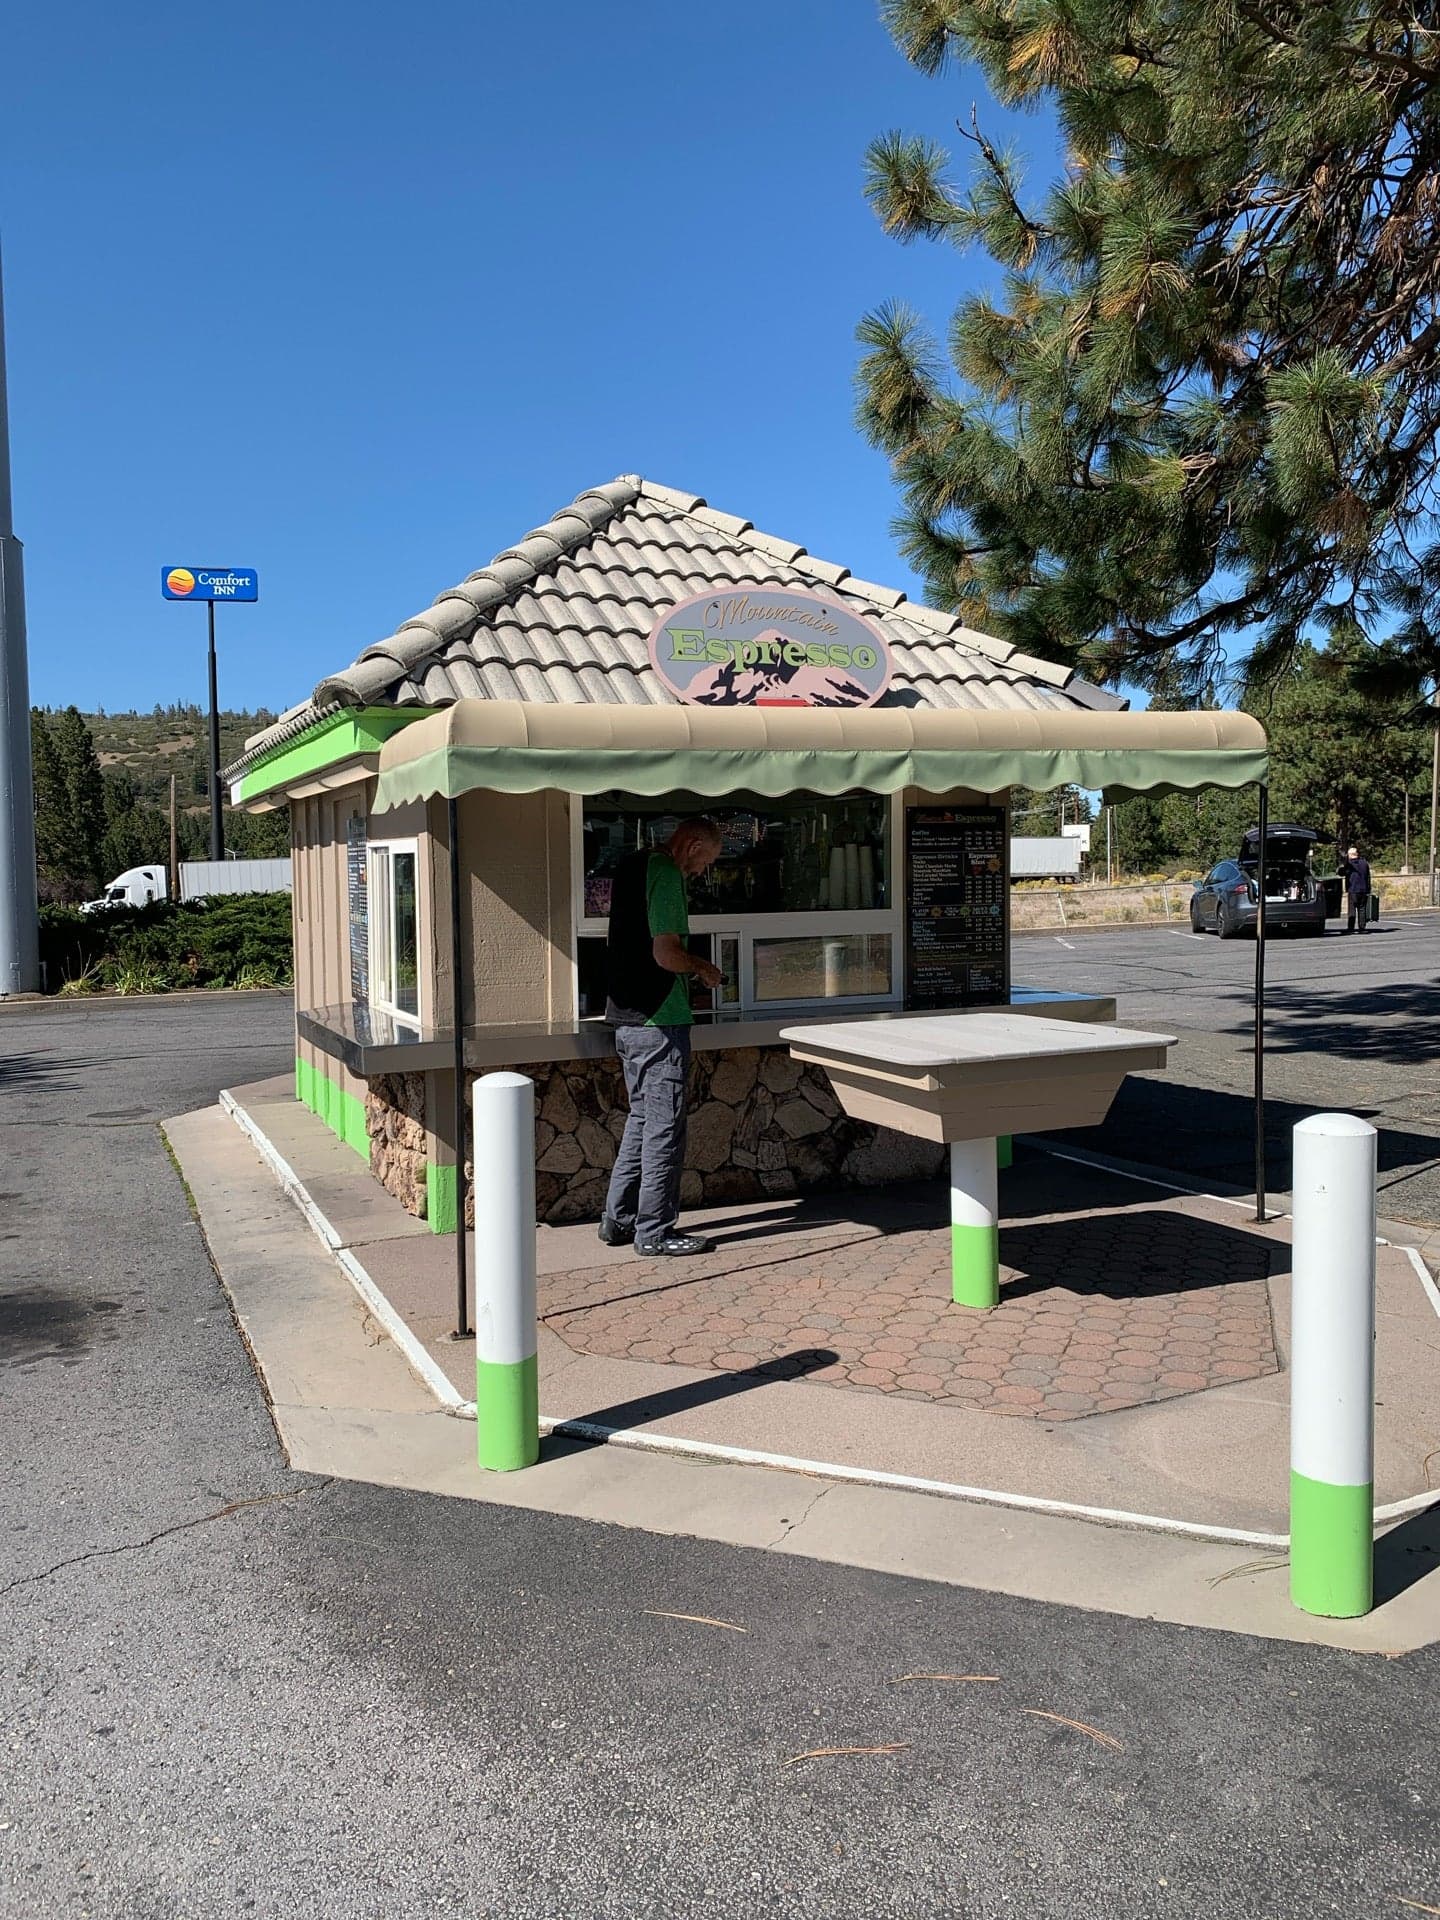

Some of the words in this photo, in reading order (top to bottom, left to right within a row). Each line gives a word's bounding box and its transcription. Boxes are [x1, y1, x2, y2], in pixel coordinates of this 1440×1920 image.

[198, 573, 251, 586] Comfort
[213, 586, 236, 595] INN
[703, 594, 839, 636] Mountain
[665, 628, 878, 673] Espresso
